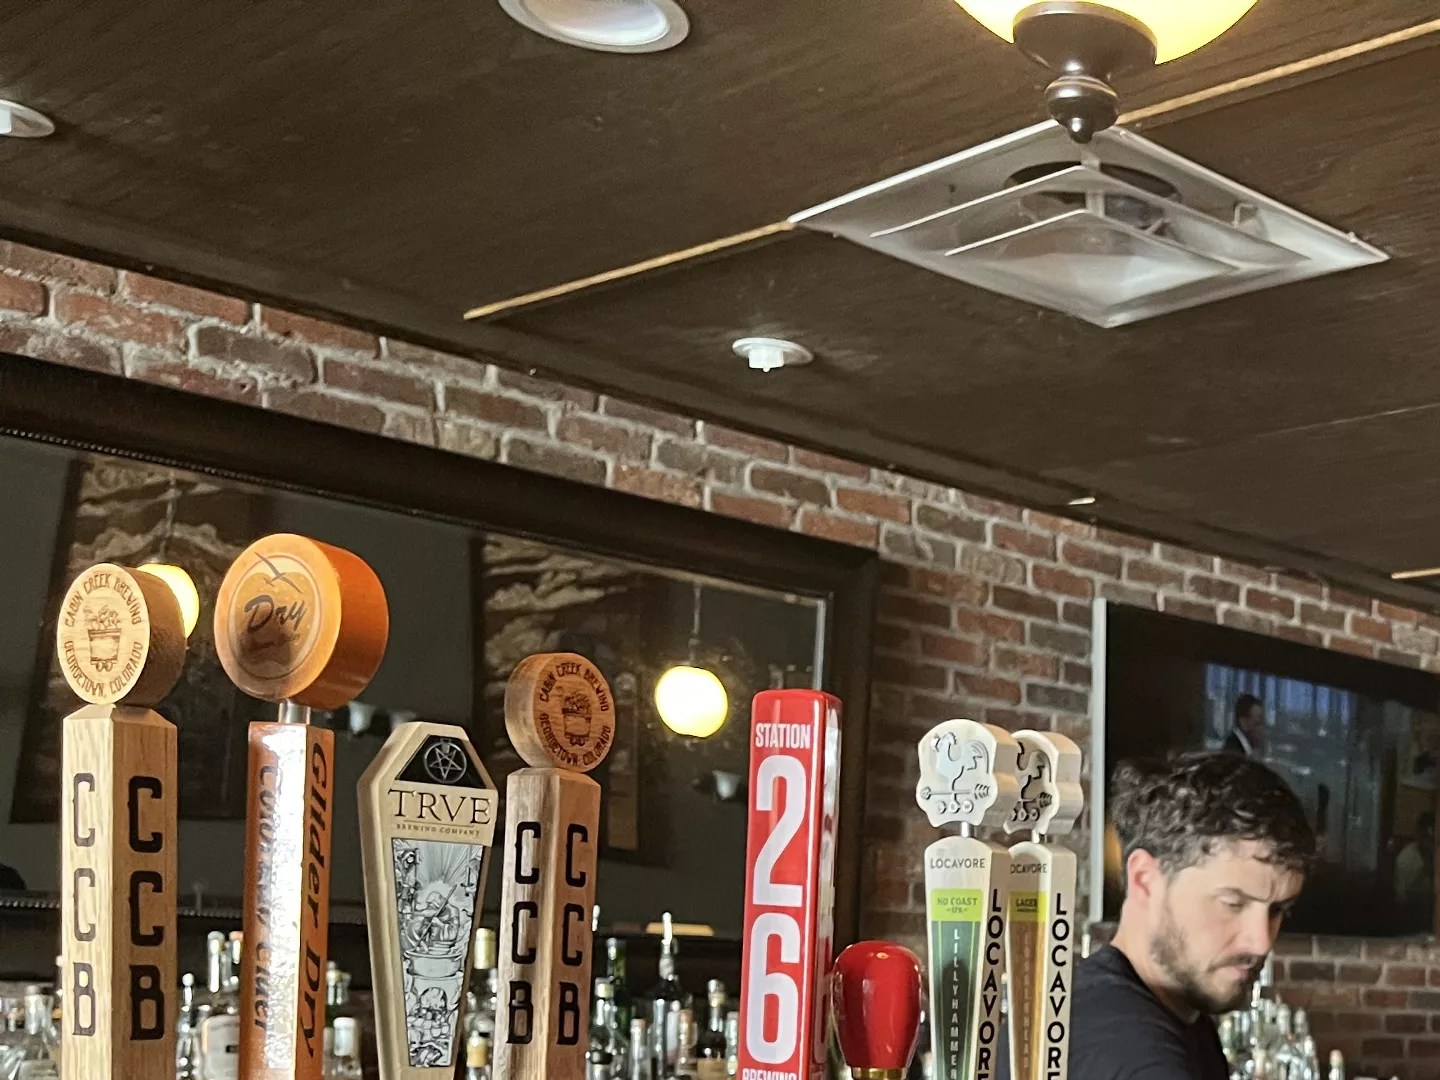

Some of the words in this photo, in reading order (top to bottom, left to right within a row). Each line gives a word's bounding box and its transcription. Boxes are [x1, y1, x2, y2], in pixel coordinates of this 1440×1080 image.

[64, 591, 84, 628] CABIN
[83, 573, 113, 595] CREEK
[113, 577, 142, 626] BREWING
[109, 641, 144, 695] COLORADO
[755, 722, 811, 749] STATION
[387, 787, 491, 825] TRVE
[307, 742, 328, 930] Glider
[396, 823, 438, 834] BREWING
[439, 826, 481, 838] COMPANY
[930, 857, 987, 870] LOCAVORE
[937, 896, 949, 907] NO
[950, 896, 977, 907] COAST
[300, 939, 321, 1059] Dry
[949, 928, 961, 1080] LILLYHAMMER
